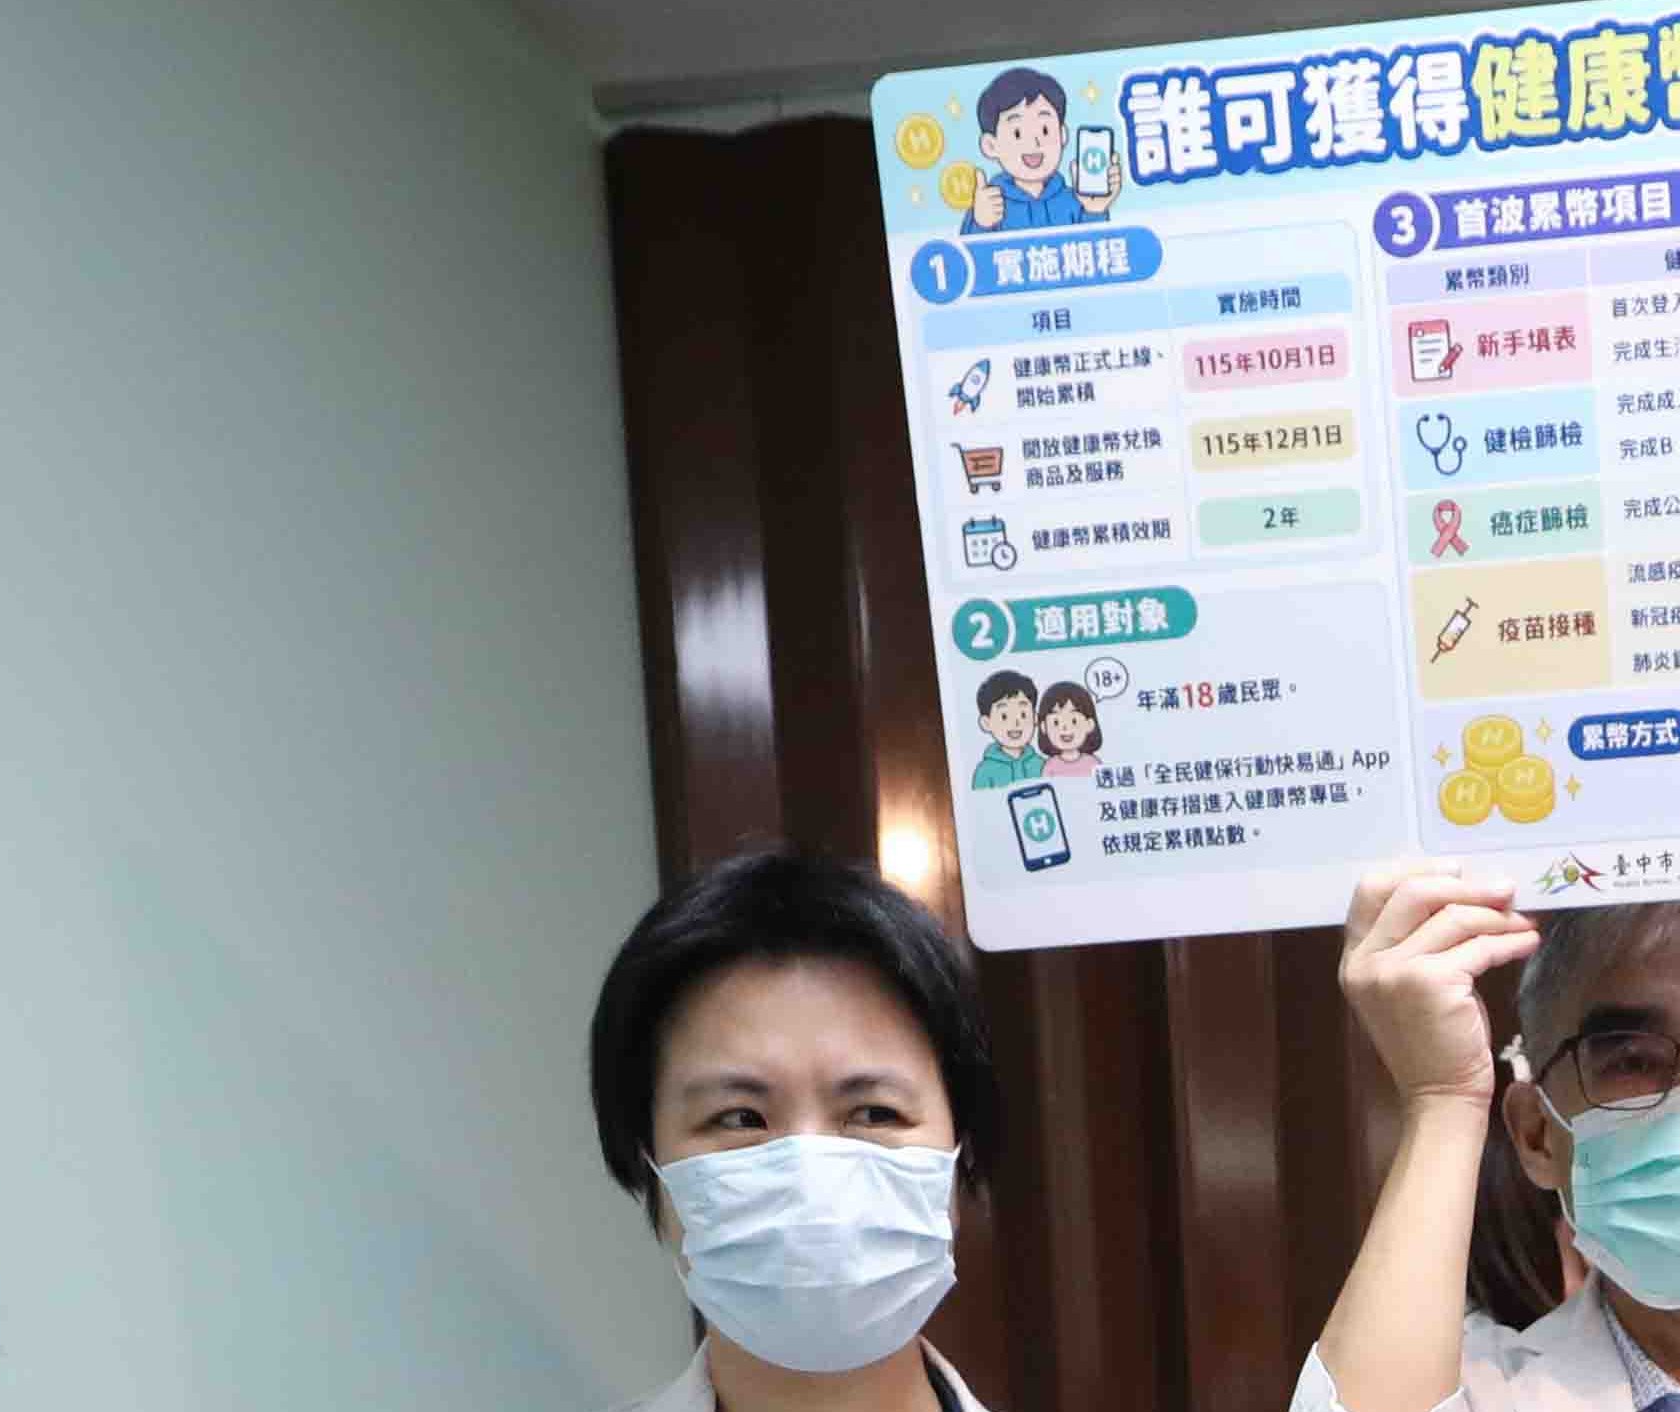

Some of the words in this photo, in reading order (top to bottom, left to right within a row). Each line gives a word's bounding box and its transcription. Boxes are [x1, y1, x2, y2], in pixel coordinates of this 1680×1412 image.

[1391, 207, 1416, 243] 3
[1454, 182, 1672, 239] 首波累幣項目
[930, 254, 947, 292] 1
[992, 238, 1131, 285] 實施期程
[1444, 264, 1530, 291] 累幣類別
[1218, 286, 1301, 316] 實施時間
[1032, 308, 1071, 332] 項目
[1477, 325, 1577, 358] 新手填表
[1195, 343, 1337, 376] 115年10月1日
[1017, 382, 1095, 408] 開始累積
[1022, 428, 1162, 458] 開放健康幣兌換
[1202, 424, 1343, 455] 115年12月1日
[1484, 422, 1584, 454] 健檢篩檢
[1026, 459, 1125, 488] 商品及服務
[1263, 506, 1300, 529] 2年
[1490, 503, 1590, 538] 癌症篩檢
[1031, 520, 1171, 551] 健康幣累積效期
[971, 617, 993, 649] 2
[1033, 598, 1170, 643] 適用對象
[1498, 608, 1596, 643] 疫苗接種
[1094, 670, 1121, 688] 18+
[1583, 718, 1679, 750] 累幣方式
[1352, 750, 1390, 770] App
